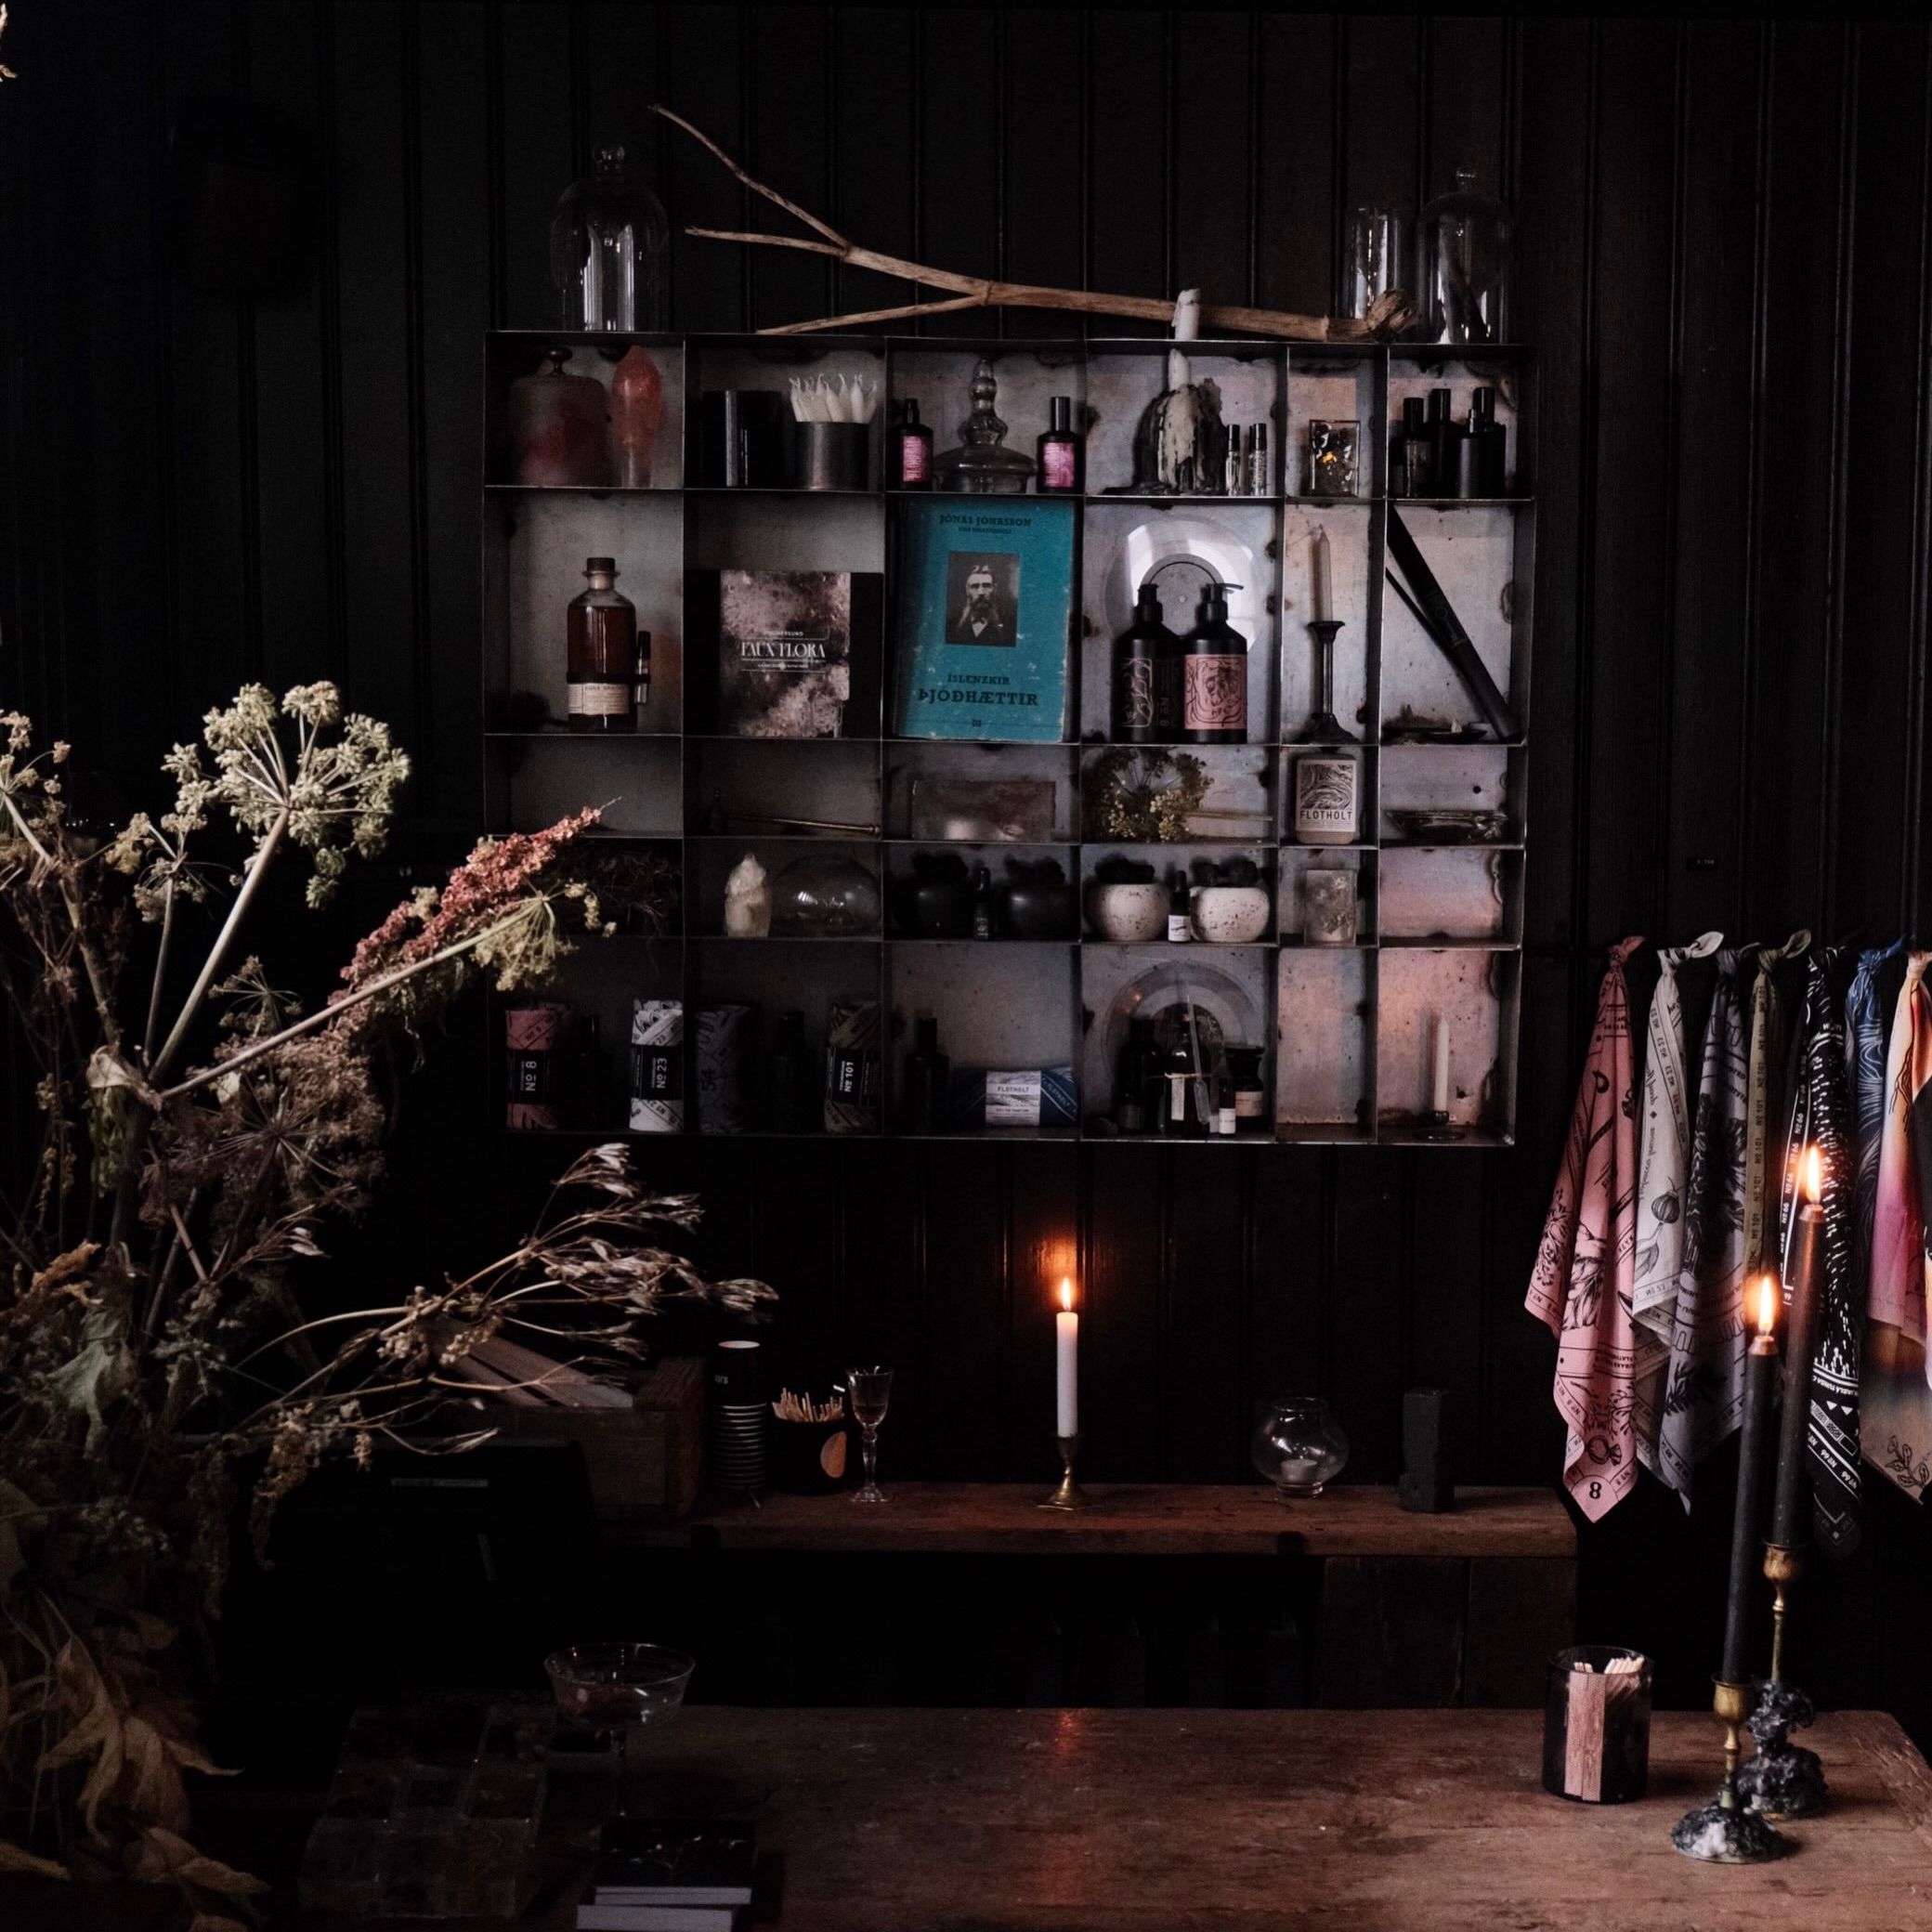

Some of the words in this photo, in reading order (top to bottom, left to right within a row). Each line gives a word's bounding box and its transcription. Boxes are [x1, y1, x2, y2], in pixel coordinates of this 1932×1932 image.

[1299, 810, 1353, 821] FLOTHOLT
[525, 1060, 538, 1069] 8
[657, 1057, 668, 1074] 23
[844, 1061, 855, 1078] 101
[1589, 1481, 1602, 1499] 8
